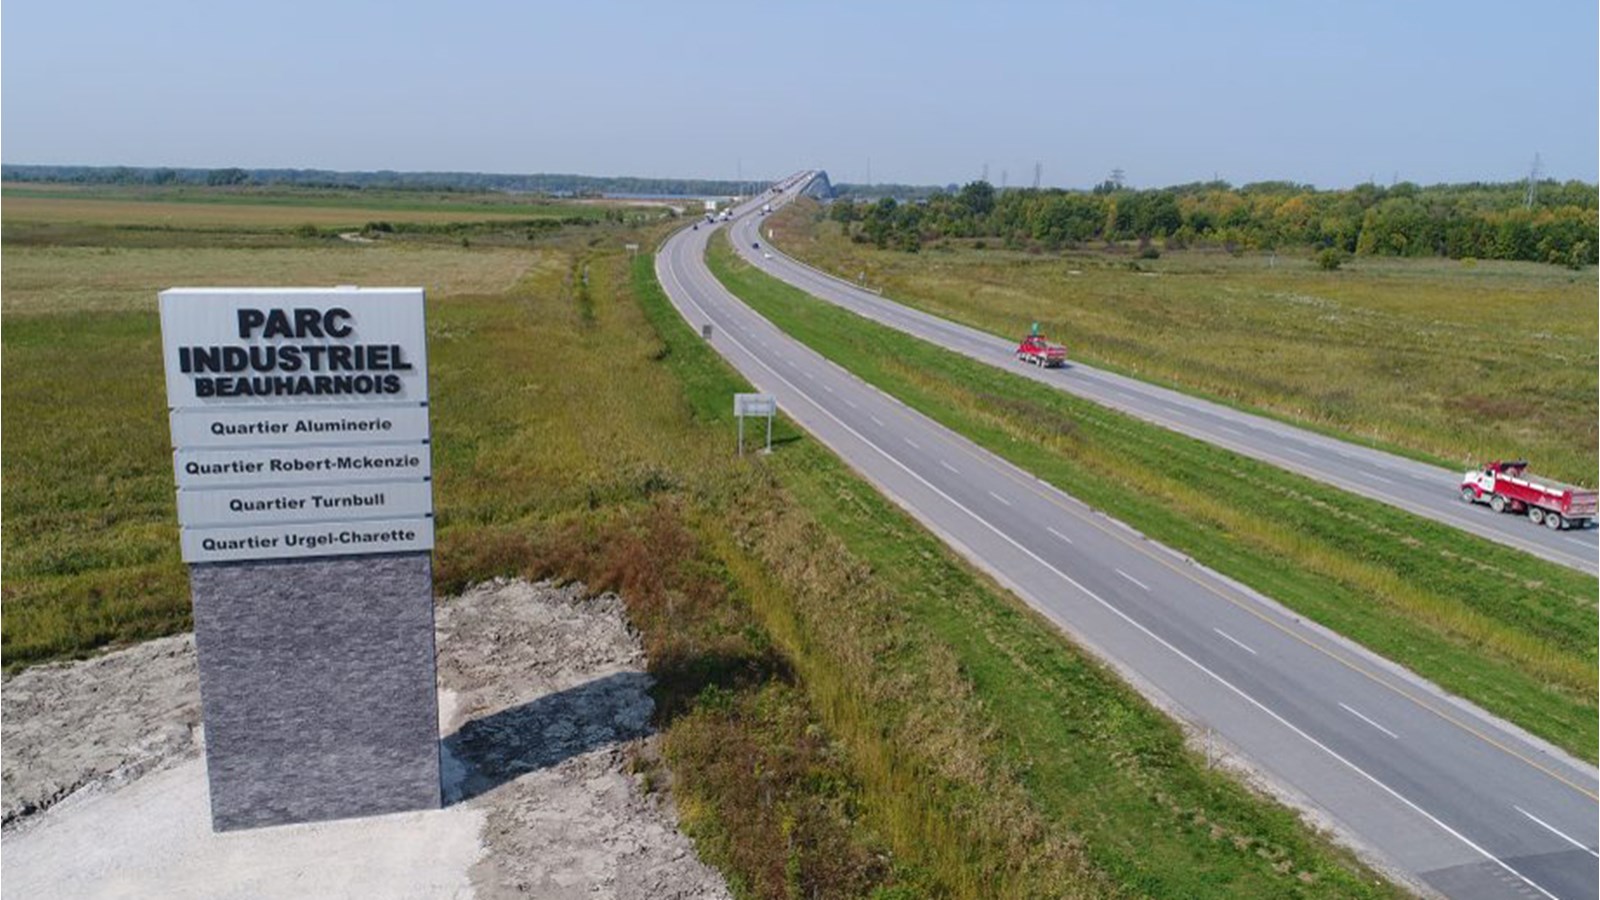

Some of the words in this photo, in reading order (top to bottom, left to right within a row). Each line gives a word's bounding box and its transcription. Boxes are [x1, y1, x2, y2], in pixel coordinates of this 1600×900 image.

[237, 308, 353, 339] PARC
[178, 344, 413, 374] INDUSTRIEL
[195, 374, 401, 398] BEAUHARNOIS
[210, 420, 289, 437] Quartier
[294, 417, 392, 433] Aluminerie
[185, 459, 264, 476] Quartier
[269, 454, 420, 472] Robert-Mckenzie
[229, 496, 306, 512] Quartier
[311, 493, 385, 509] Turnbull
[201, 535, 280, 552] Quartier
[284, 529, 416, 549] Urgel-Charette
